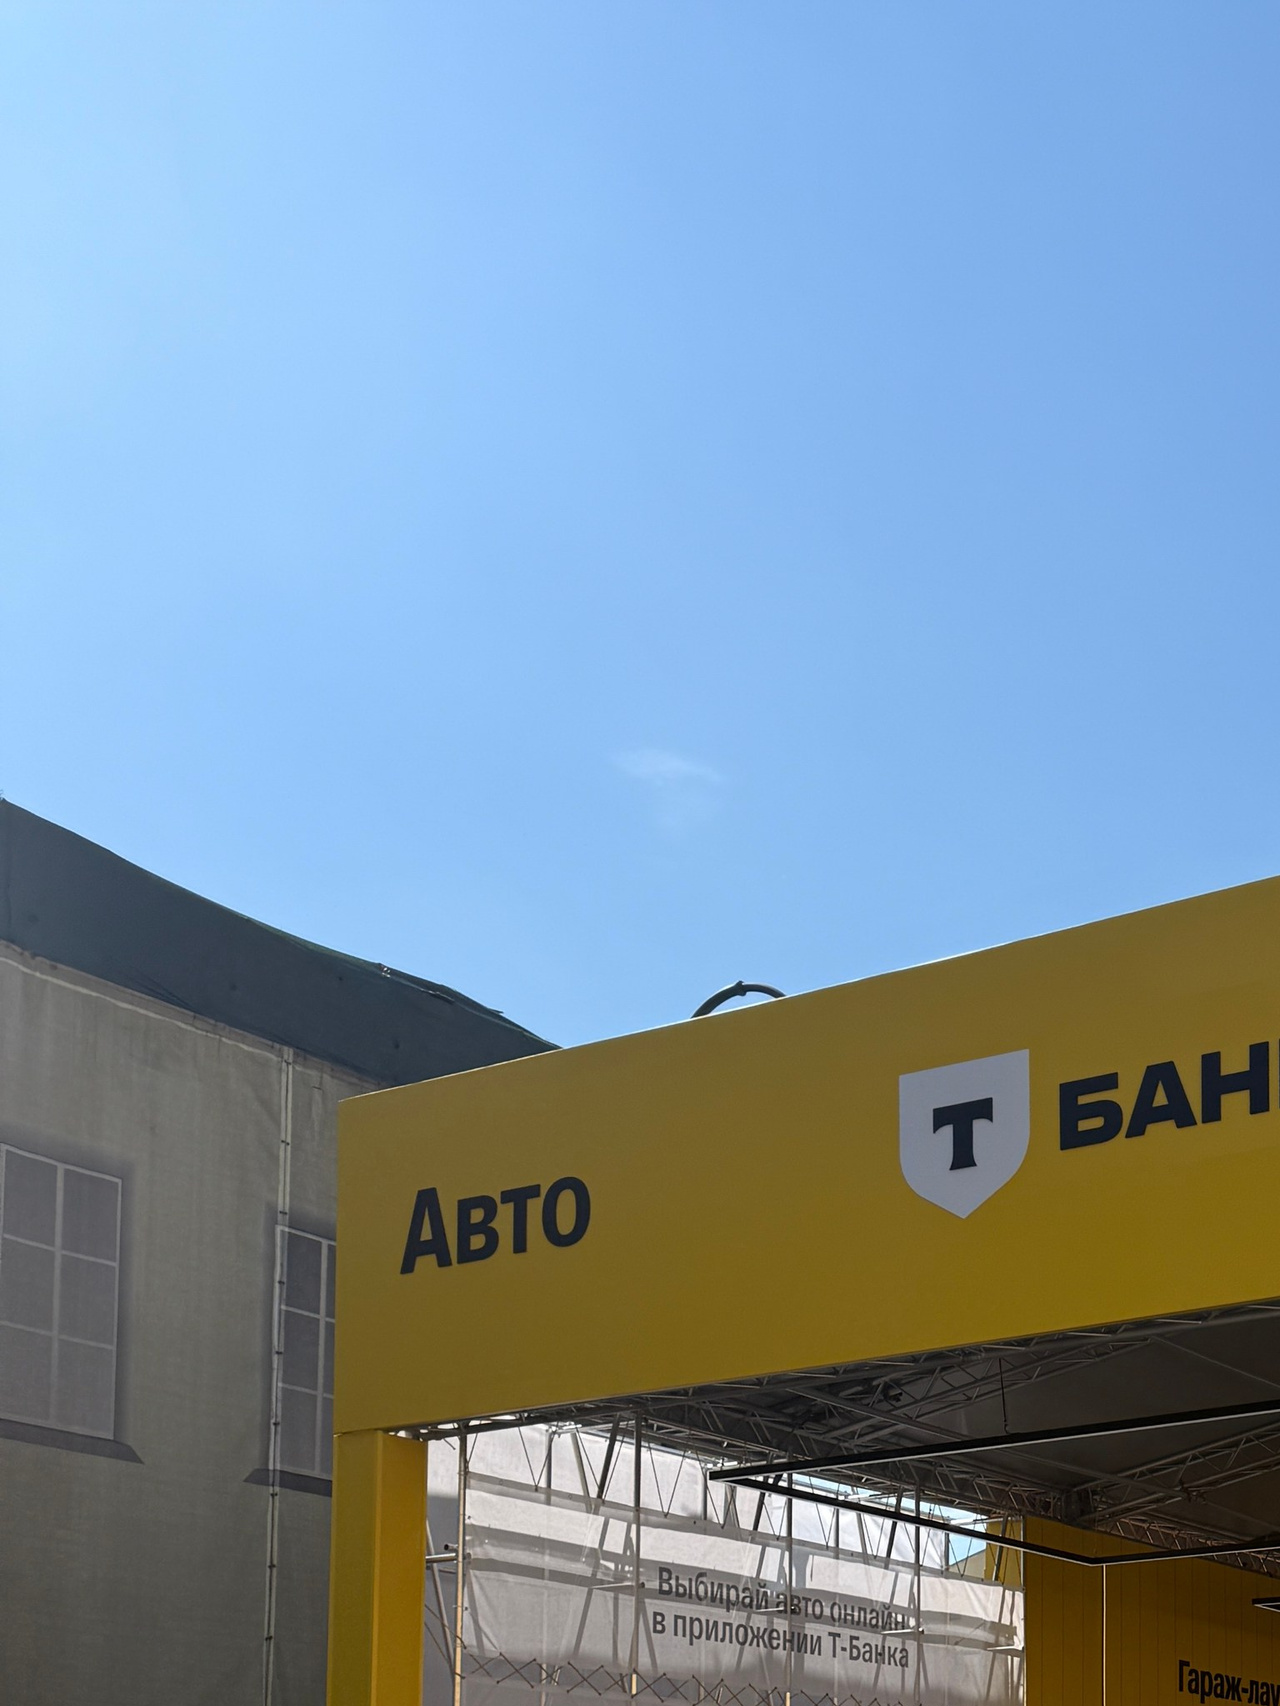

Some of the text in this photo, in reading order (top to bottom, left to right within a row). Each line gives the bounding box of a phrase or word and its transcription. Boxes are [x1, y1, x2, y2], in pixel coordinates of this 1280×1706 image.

[658, 1566, 905, 1632] Выбирай авто онлайн
[652, 1611, 909, 1669] в приложении Т-Банка
